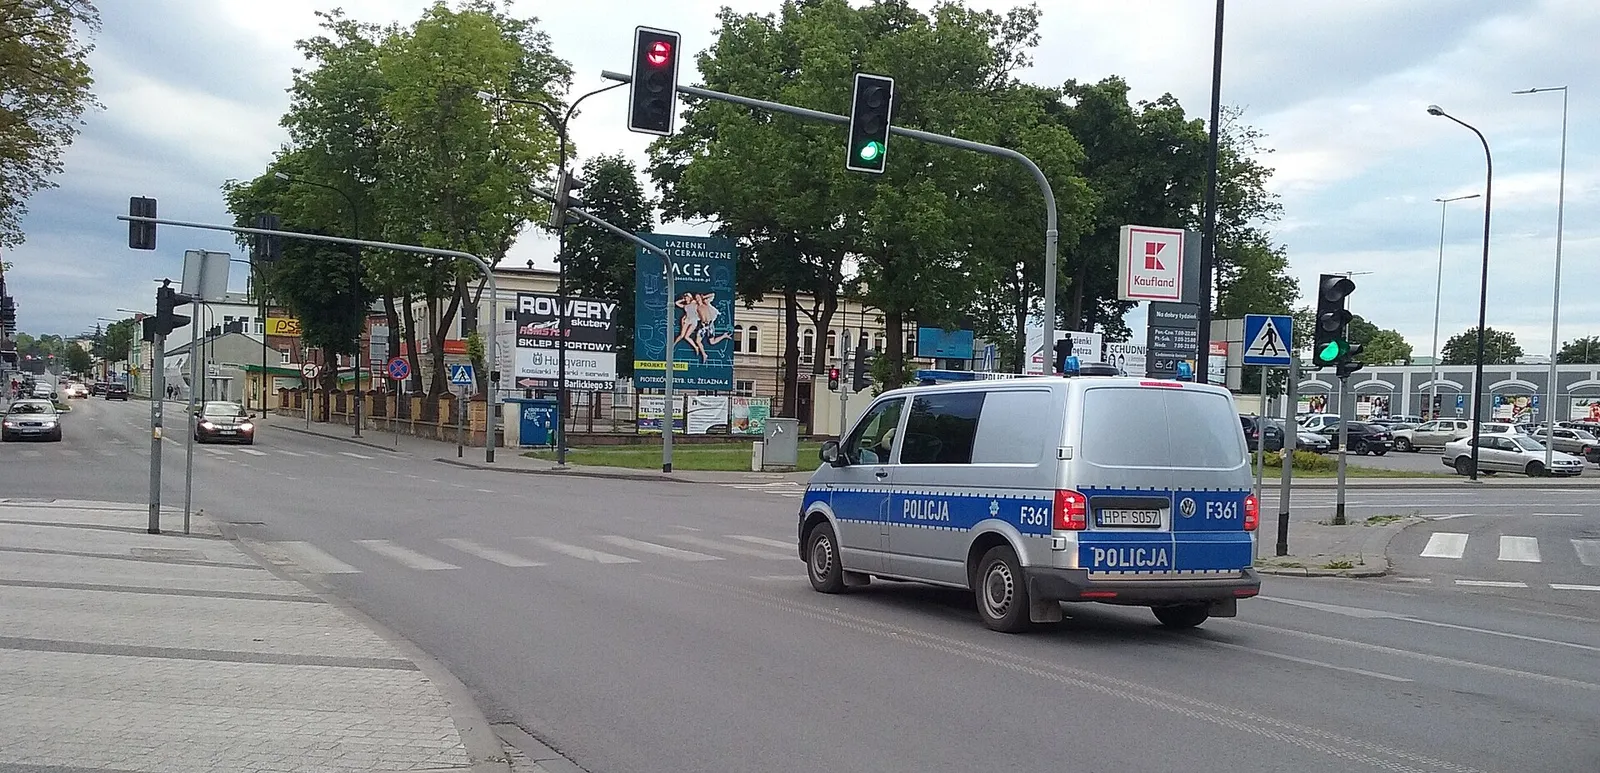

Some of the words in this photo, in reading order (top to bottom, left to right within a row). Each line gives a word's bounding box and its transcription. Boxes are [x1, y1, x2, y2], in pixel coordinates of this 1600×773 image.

[665, 240, 706, 250] ŁAZIENKI
[674, 249, 731, 260] CERAMICZNE
[1134, 275, 1175, 288] Kaufland
[519, 296, 616, 320] ROWERY
[570, 318, 611, 331] skutery
[518, 339, 553, 349] SKLEP
[544, 356, 597, 369] Huqvarna
[521, 366, 552, 375] kosiarki
[563, 379, 604, 390] Barlickiego
[604, 381, 614, 390] 35
[903, 499, 949, 522] POLICJA
[1020, 506, 1048, 527] F361
[1104, 510, 1127, 523] HPF
[1206, 501, 1237, 520] F361
[1094, 548, 1169, 567] POLICJA
